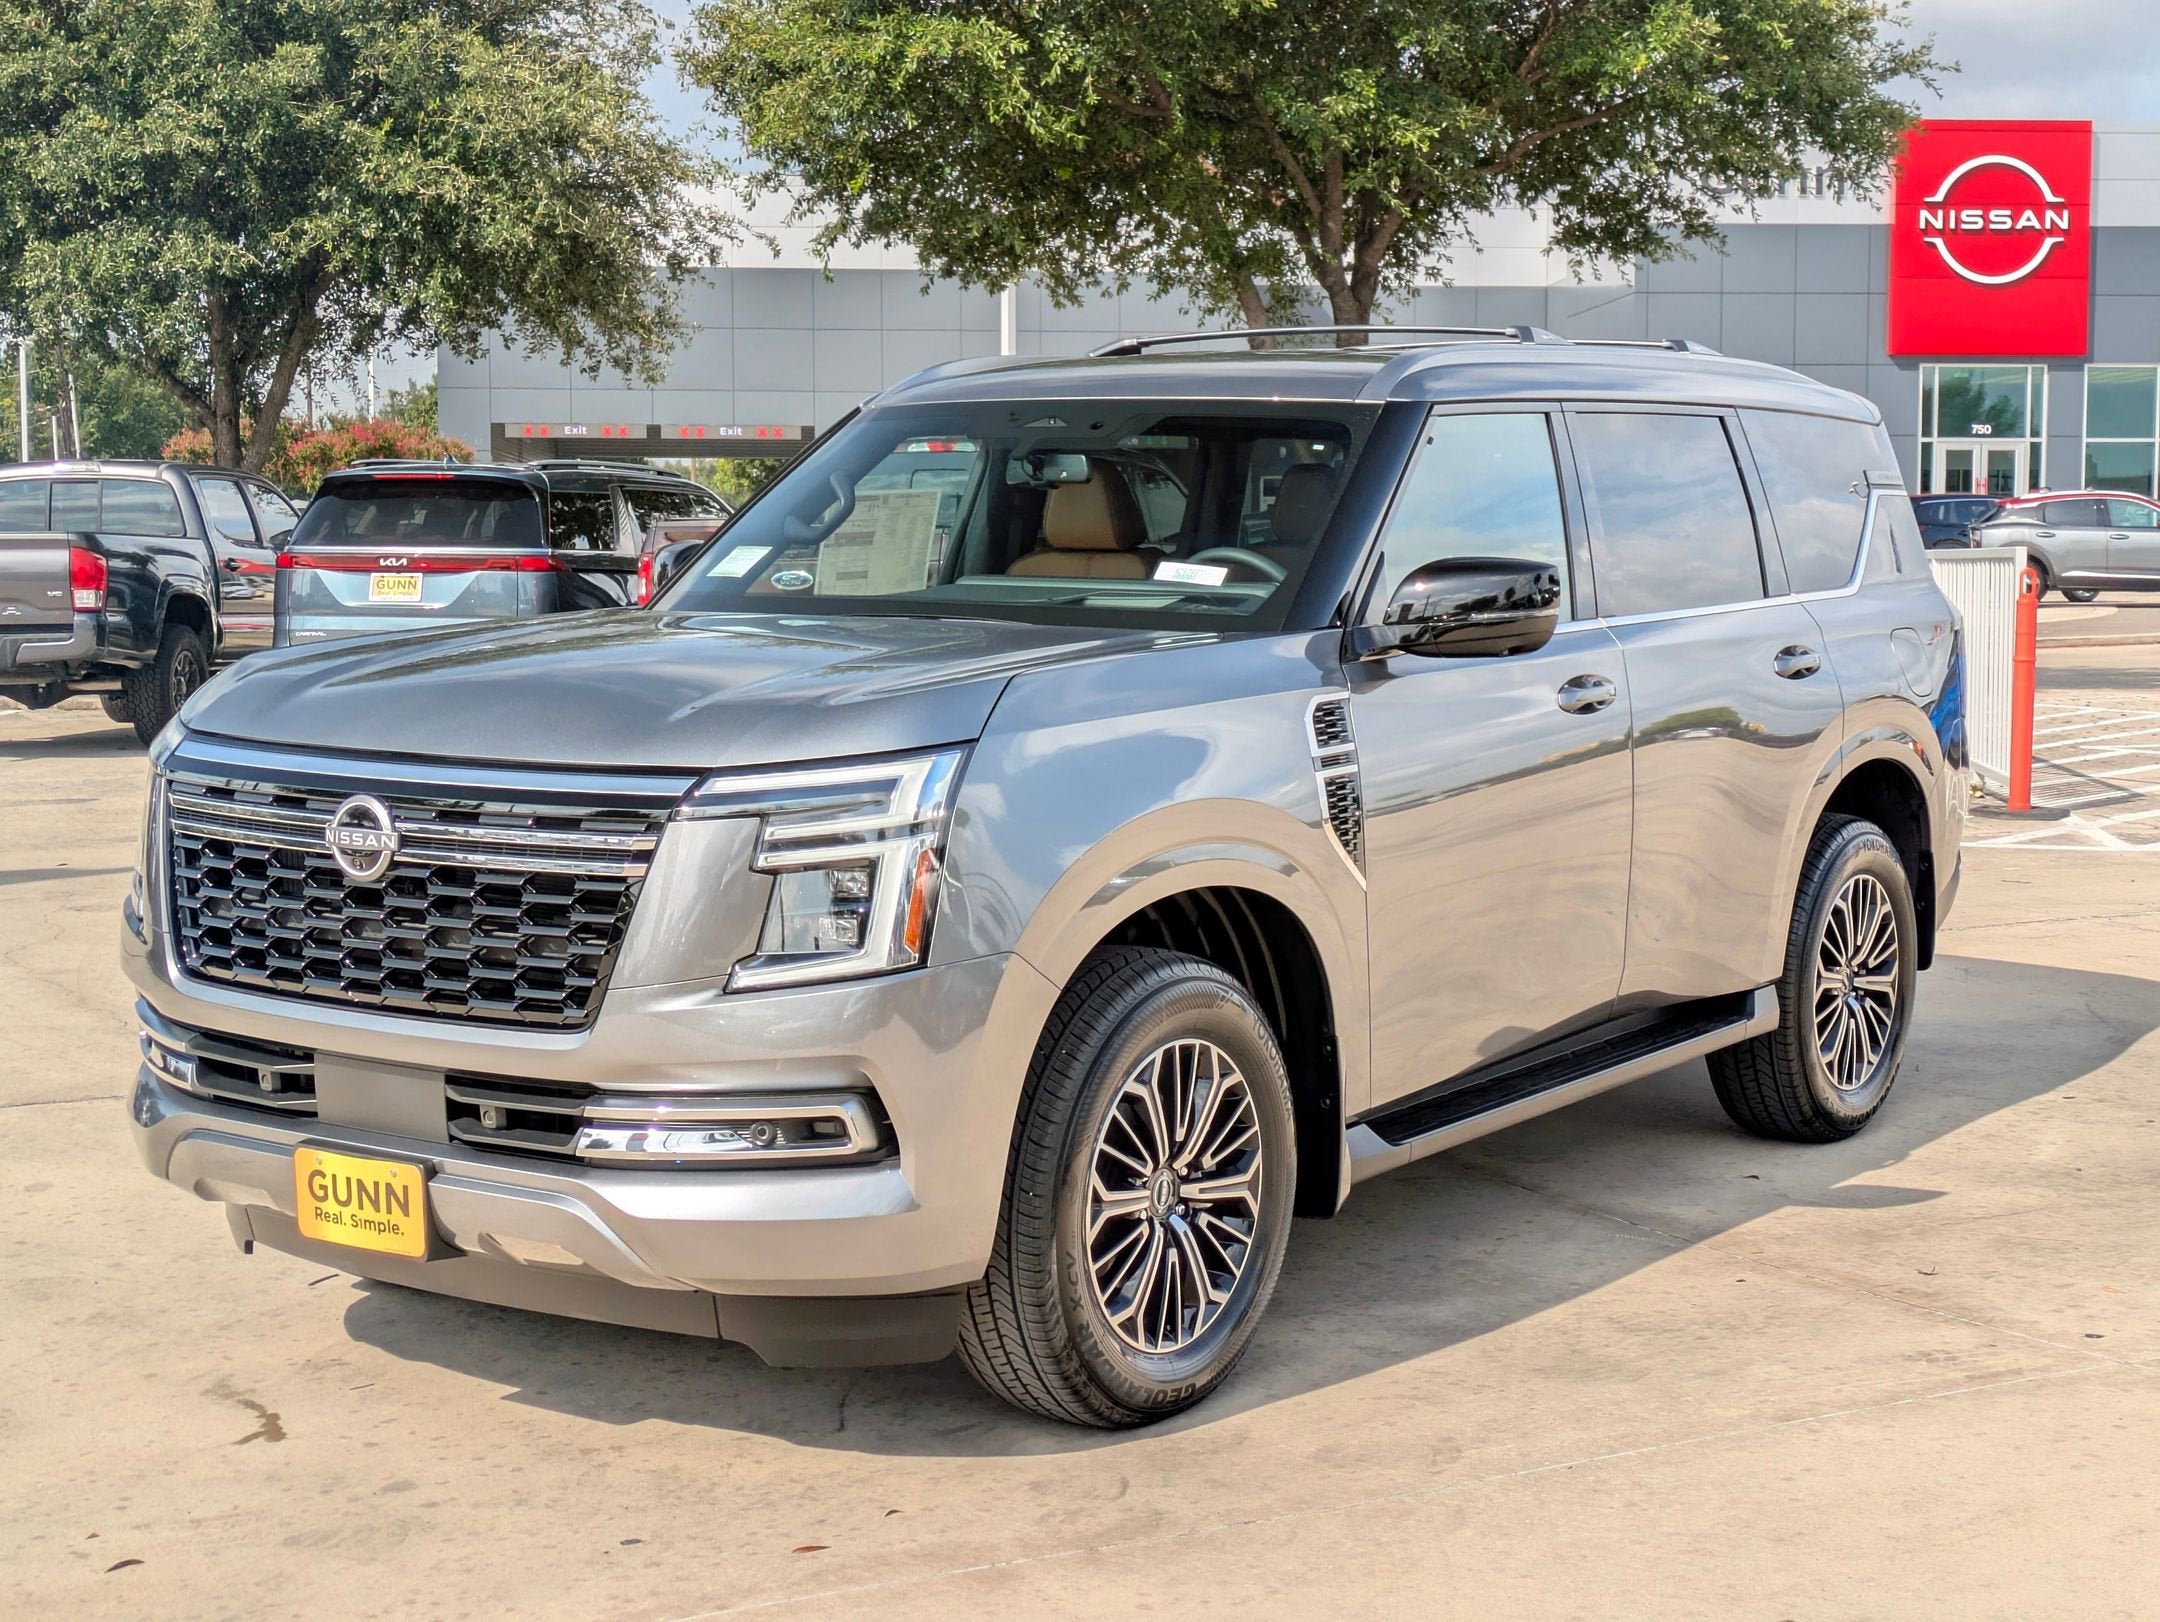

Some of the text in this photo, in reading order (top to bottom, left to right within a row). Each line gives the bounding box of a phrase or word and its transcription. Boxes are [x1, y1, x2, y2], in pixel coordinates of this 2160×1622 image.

[1919, 208, 2069, 231] NISSAN
[563, 424, 588, 435] Exit
[719, 425, 743, 436] Exit
[1971, 423, 1992, 435] 750
[379, 557, 408, 567] KIA
[376, 579, 417, 591] GUNN
[326, 828, 396, 849] NISSAN
[1251, 1012, 1293, 1121] YOKOHAMA
[307, 1168, 410, 1218] GUNN
[314, 1206, 405, 1236] Real. Simple.
